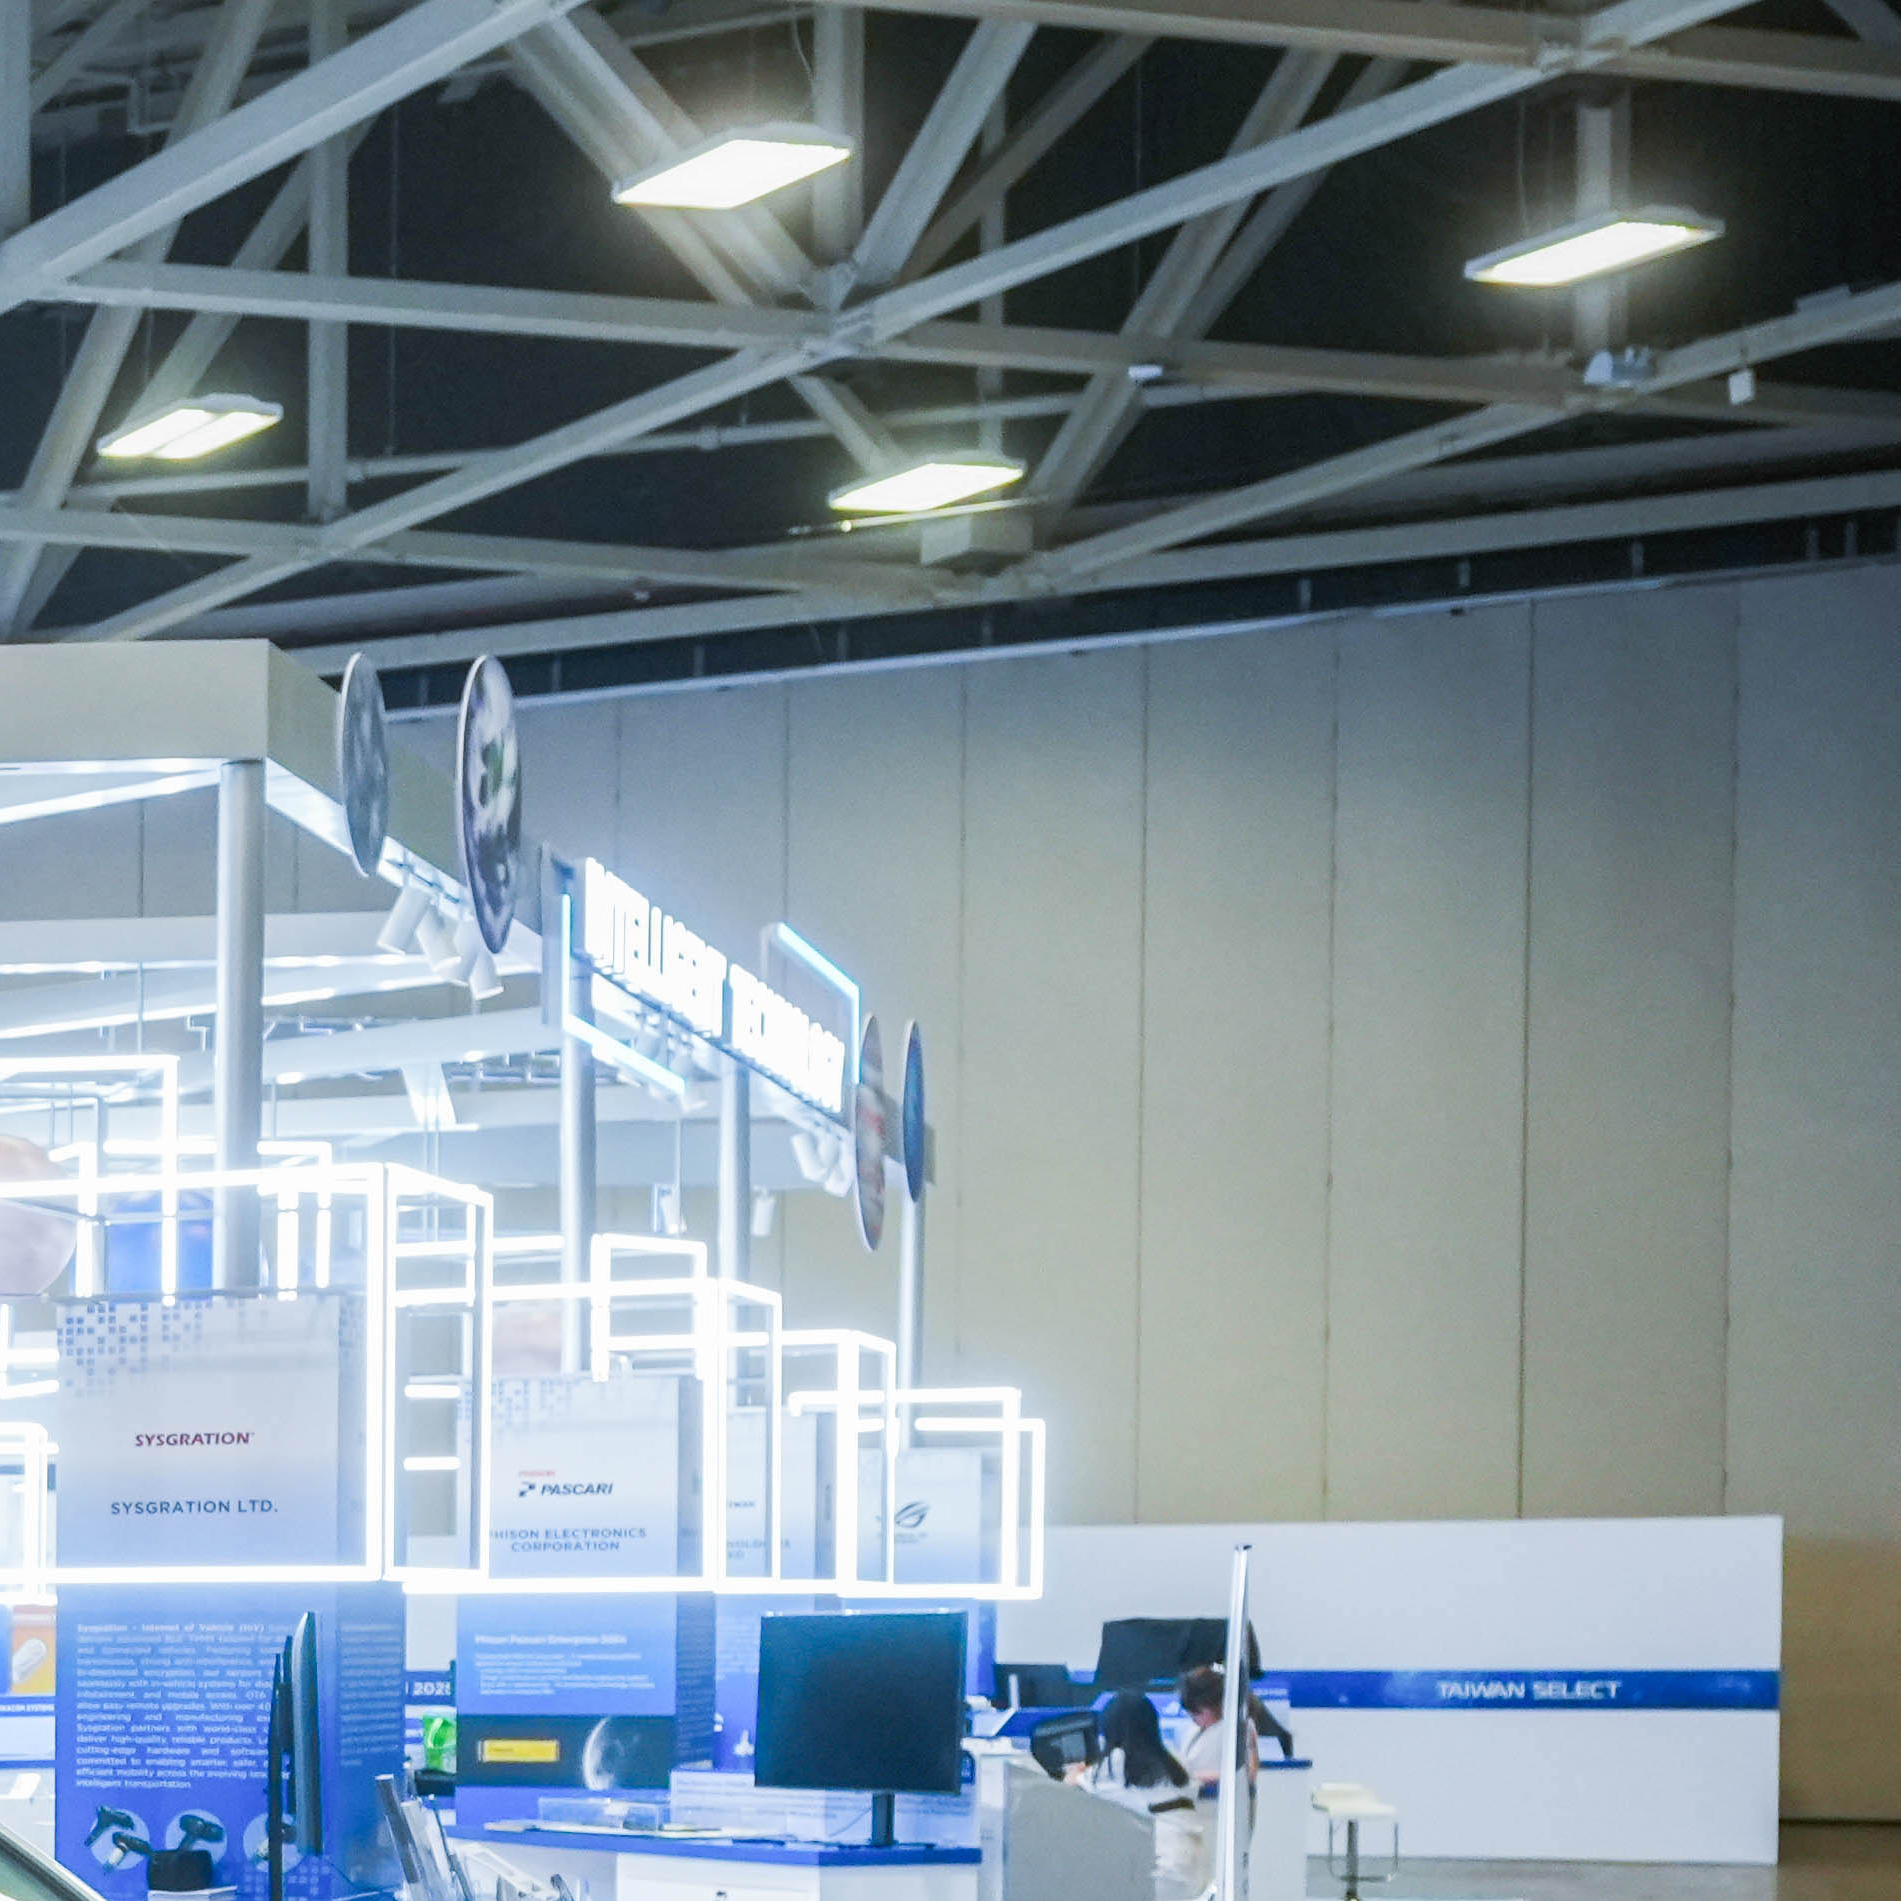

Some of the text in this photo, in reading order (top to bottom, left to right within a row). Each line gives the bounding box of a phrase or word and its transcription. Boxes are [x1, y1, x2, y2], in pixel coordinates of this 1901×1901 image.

[135, 1432, 250, 1447] SYSGRATION
[541, 1483, 613, 1496] PASCARI
[111, 1499, 278, 1515] SYSGRATION LTD.
[545, 1527, 647, 1538] ELECTRONICS
[511, 1541, 620, 1551] CORPORATION
[1437, 1681, 1622, 1699] TAIWAN SELECT
